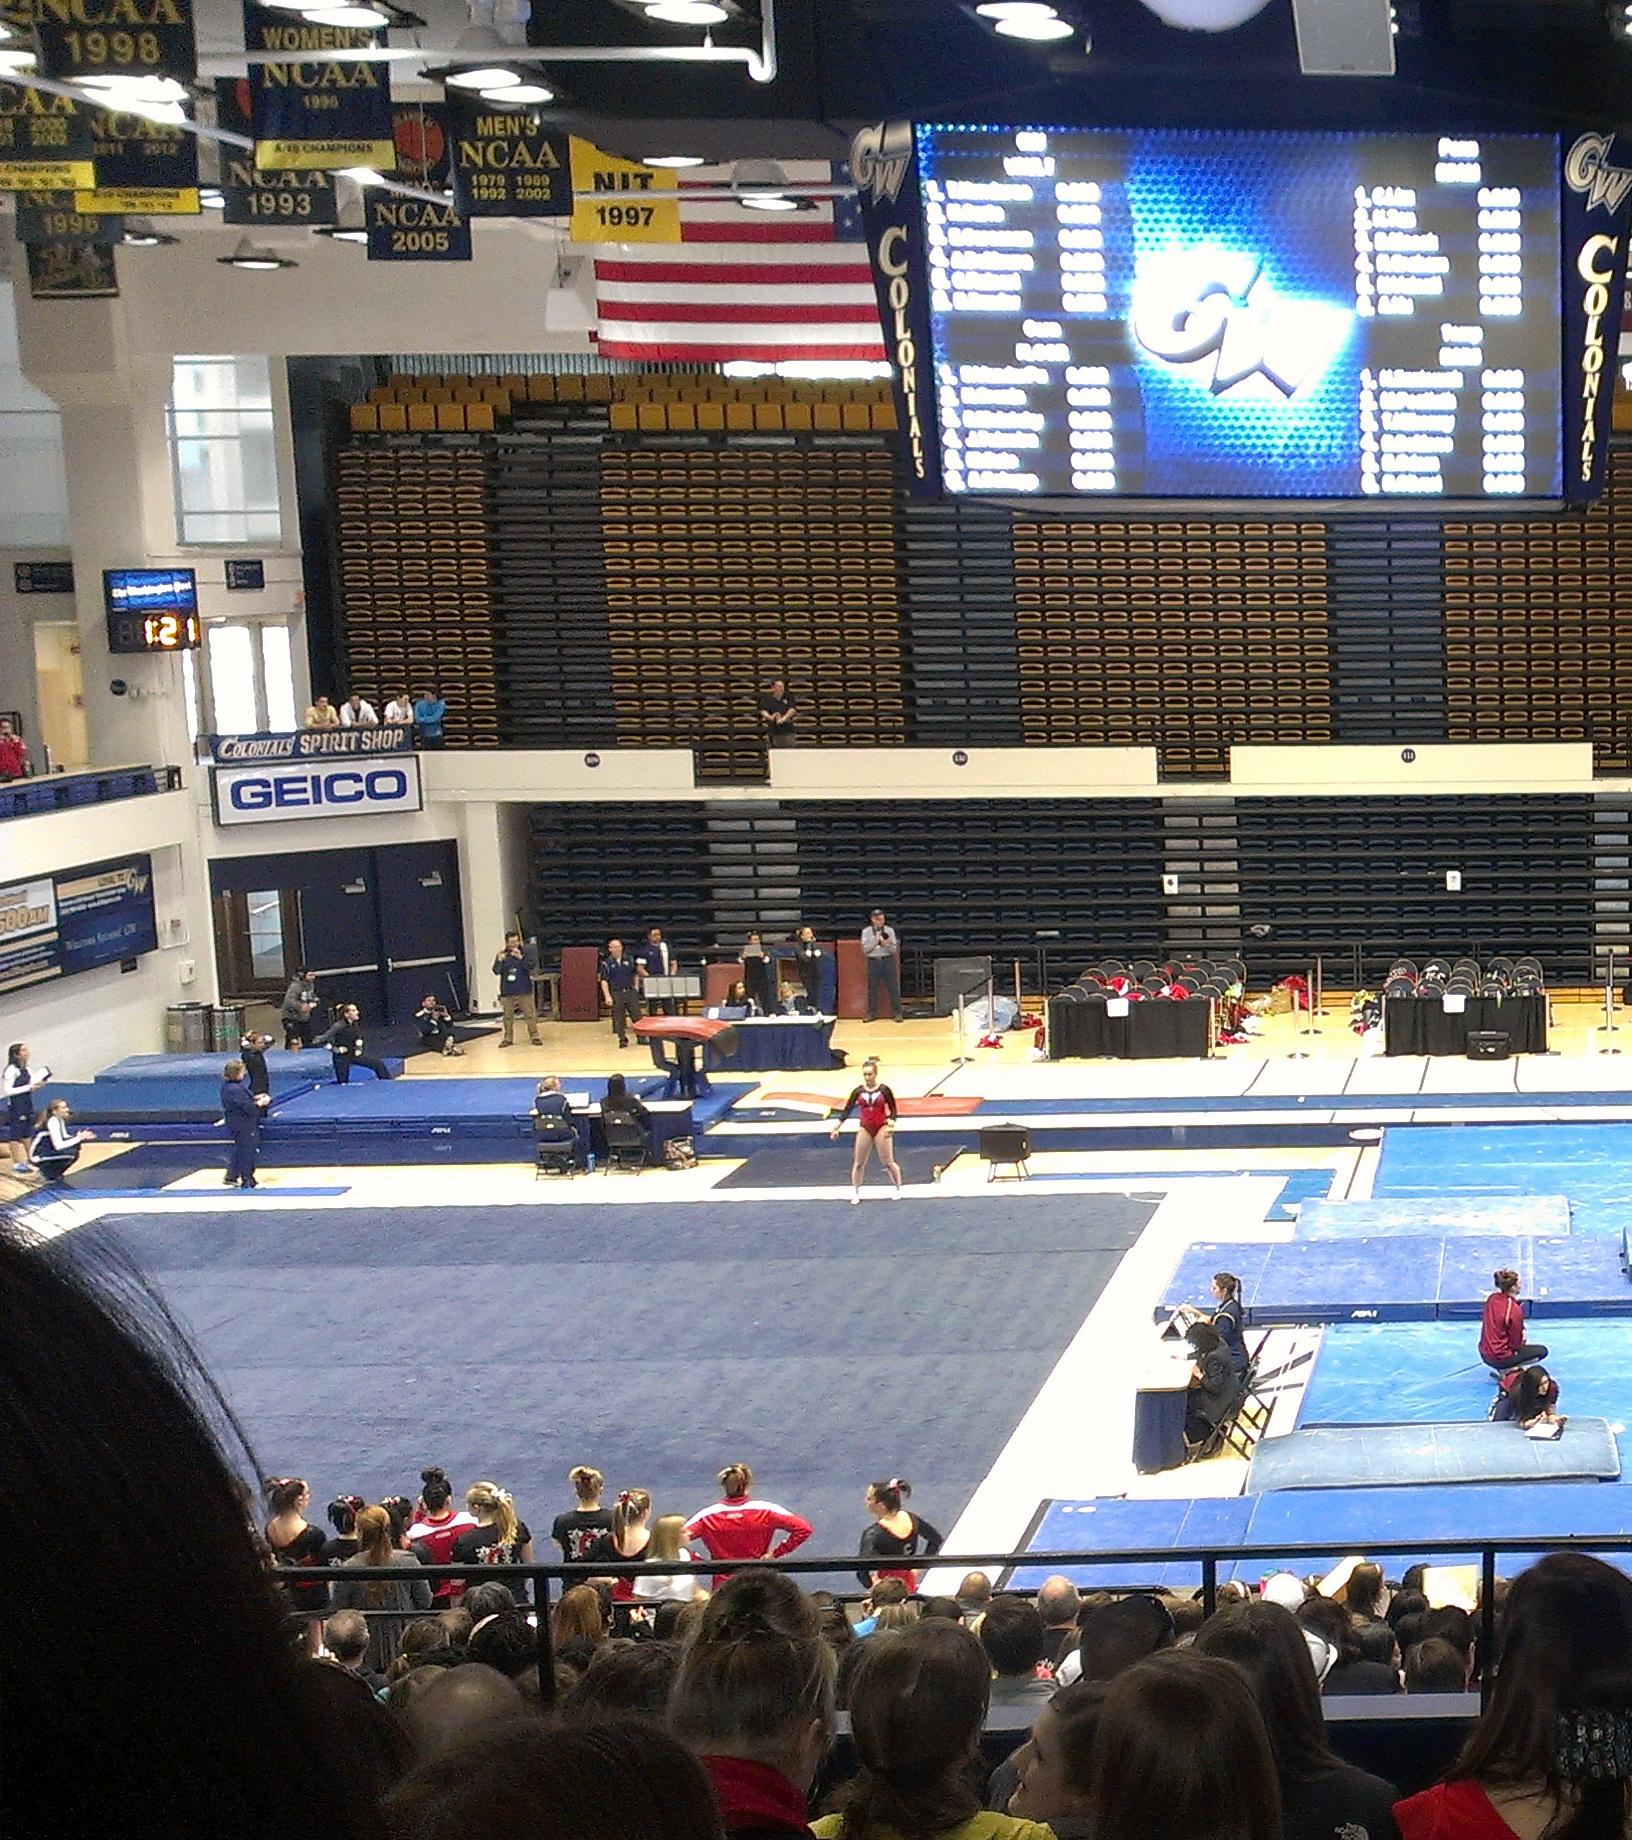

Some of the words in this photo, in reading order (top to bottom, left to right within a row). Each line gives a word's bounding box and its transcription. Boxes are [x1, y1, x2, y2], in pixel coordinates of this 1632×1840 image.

[65, 31, 161, 64] 1998
[262, 27, 376, 49] WOMEN'S
[262, 62, 378, 88] NCAA
[476, 116, 538, 137] MEN'S
[458, 140, 561, 168] NCAA
[228, 161, 329, 188] NCAA
[594, 171, 655, 190] NIT
[247, 192, 312, 216] 1993
[374, 202, 463, 228] NCAA
[596, 205, 655, 227] 1997
[392, 230, 450, 253] 2005
[878, 224, 926, 480] COLONIALS
[1577, 234, 1617, 484] COLONIALS
[219, 736, 297, 759] COLONIALS
[300, 732, 361, 753] SPIRIT
[360, 728, 405, 749] SHOP
[230, 769, 408, 810] GEICO
